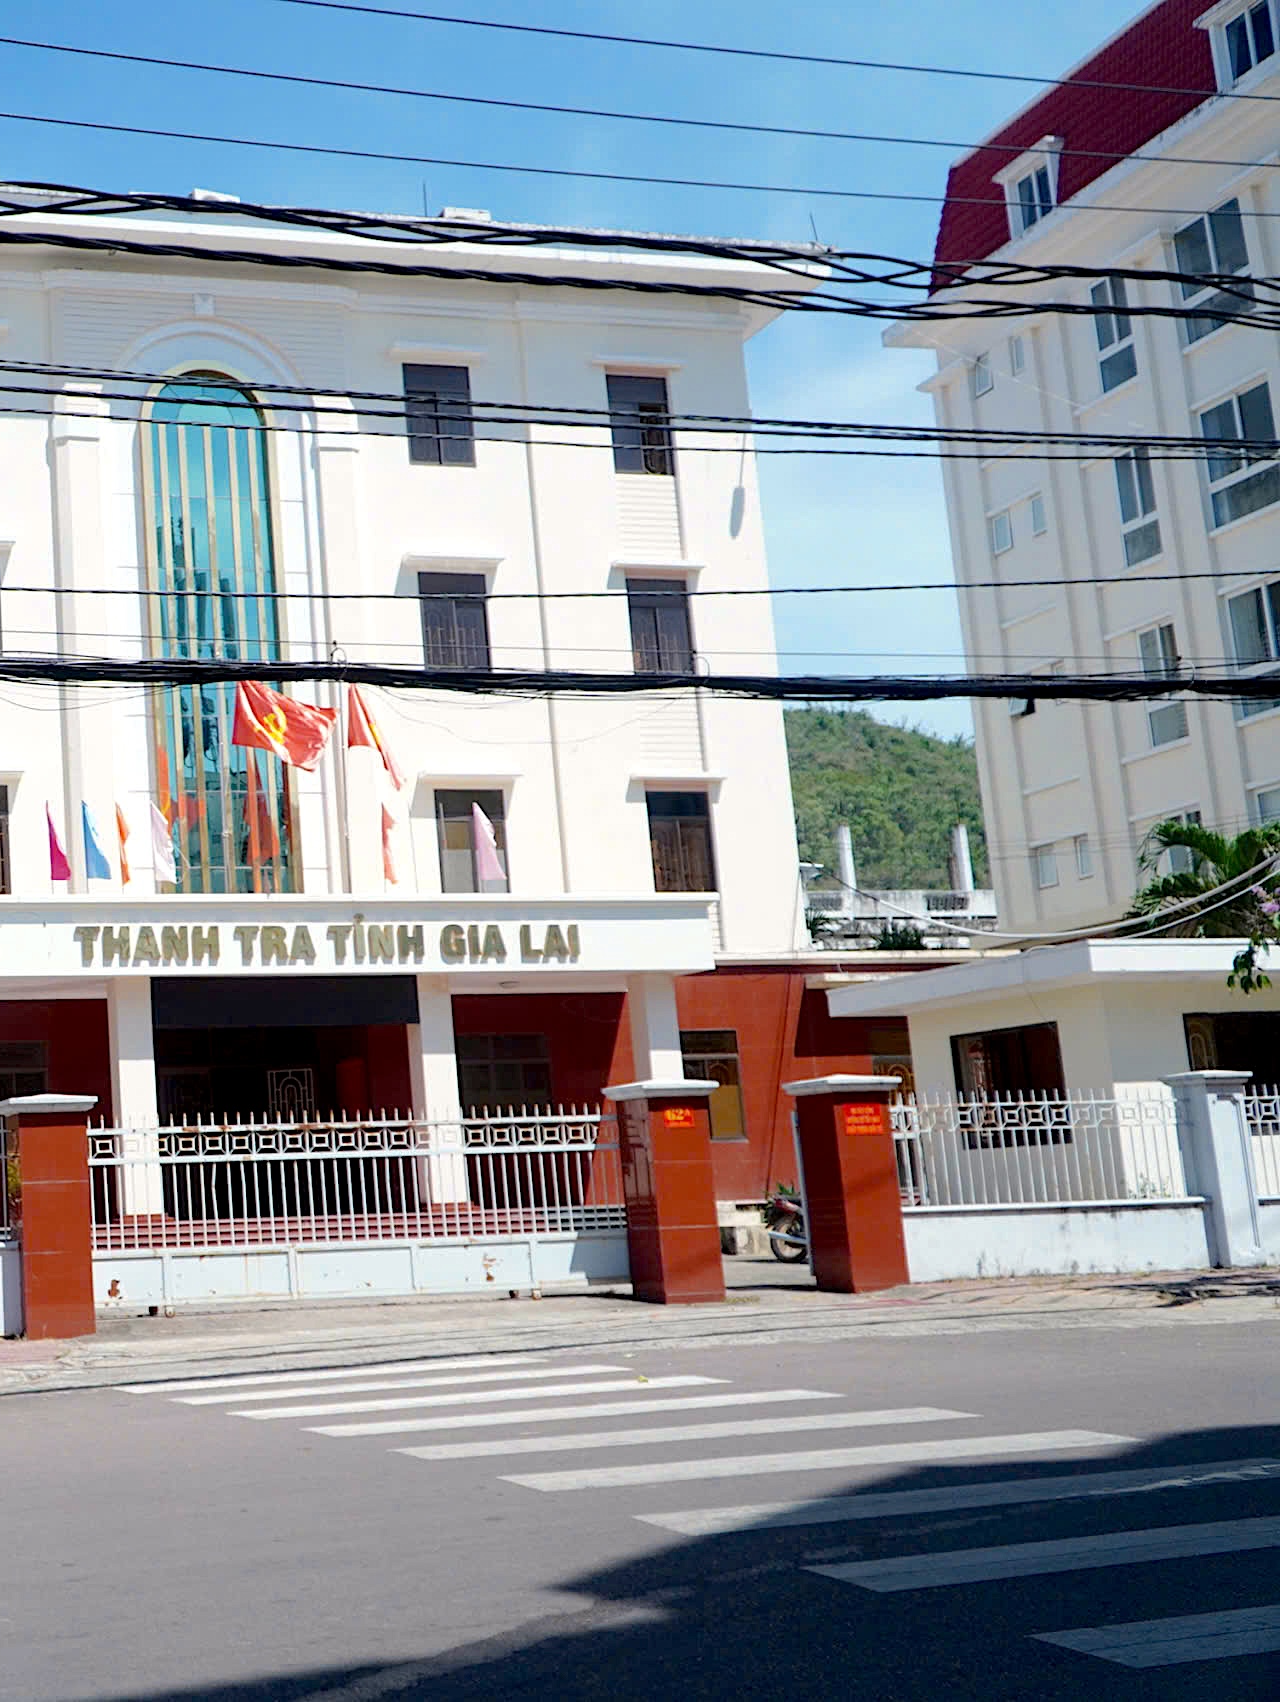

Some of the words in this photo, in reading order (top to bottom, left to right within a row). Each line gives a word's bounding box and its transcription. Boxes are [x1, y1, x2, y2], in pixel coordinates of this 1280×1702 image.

[74, 925, 220, 967] THANH
[234, 925, 317, 966] TRA
[326, 912, 425, 965] TỈNH
[440, 924, 507, 965] GIA
[520, 924, 580, 964] LAI
